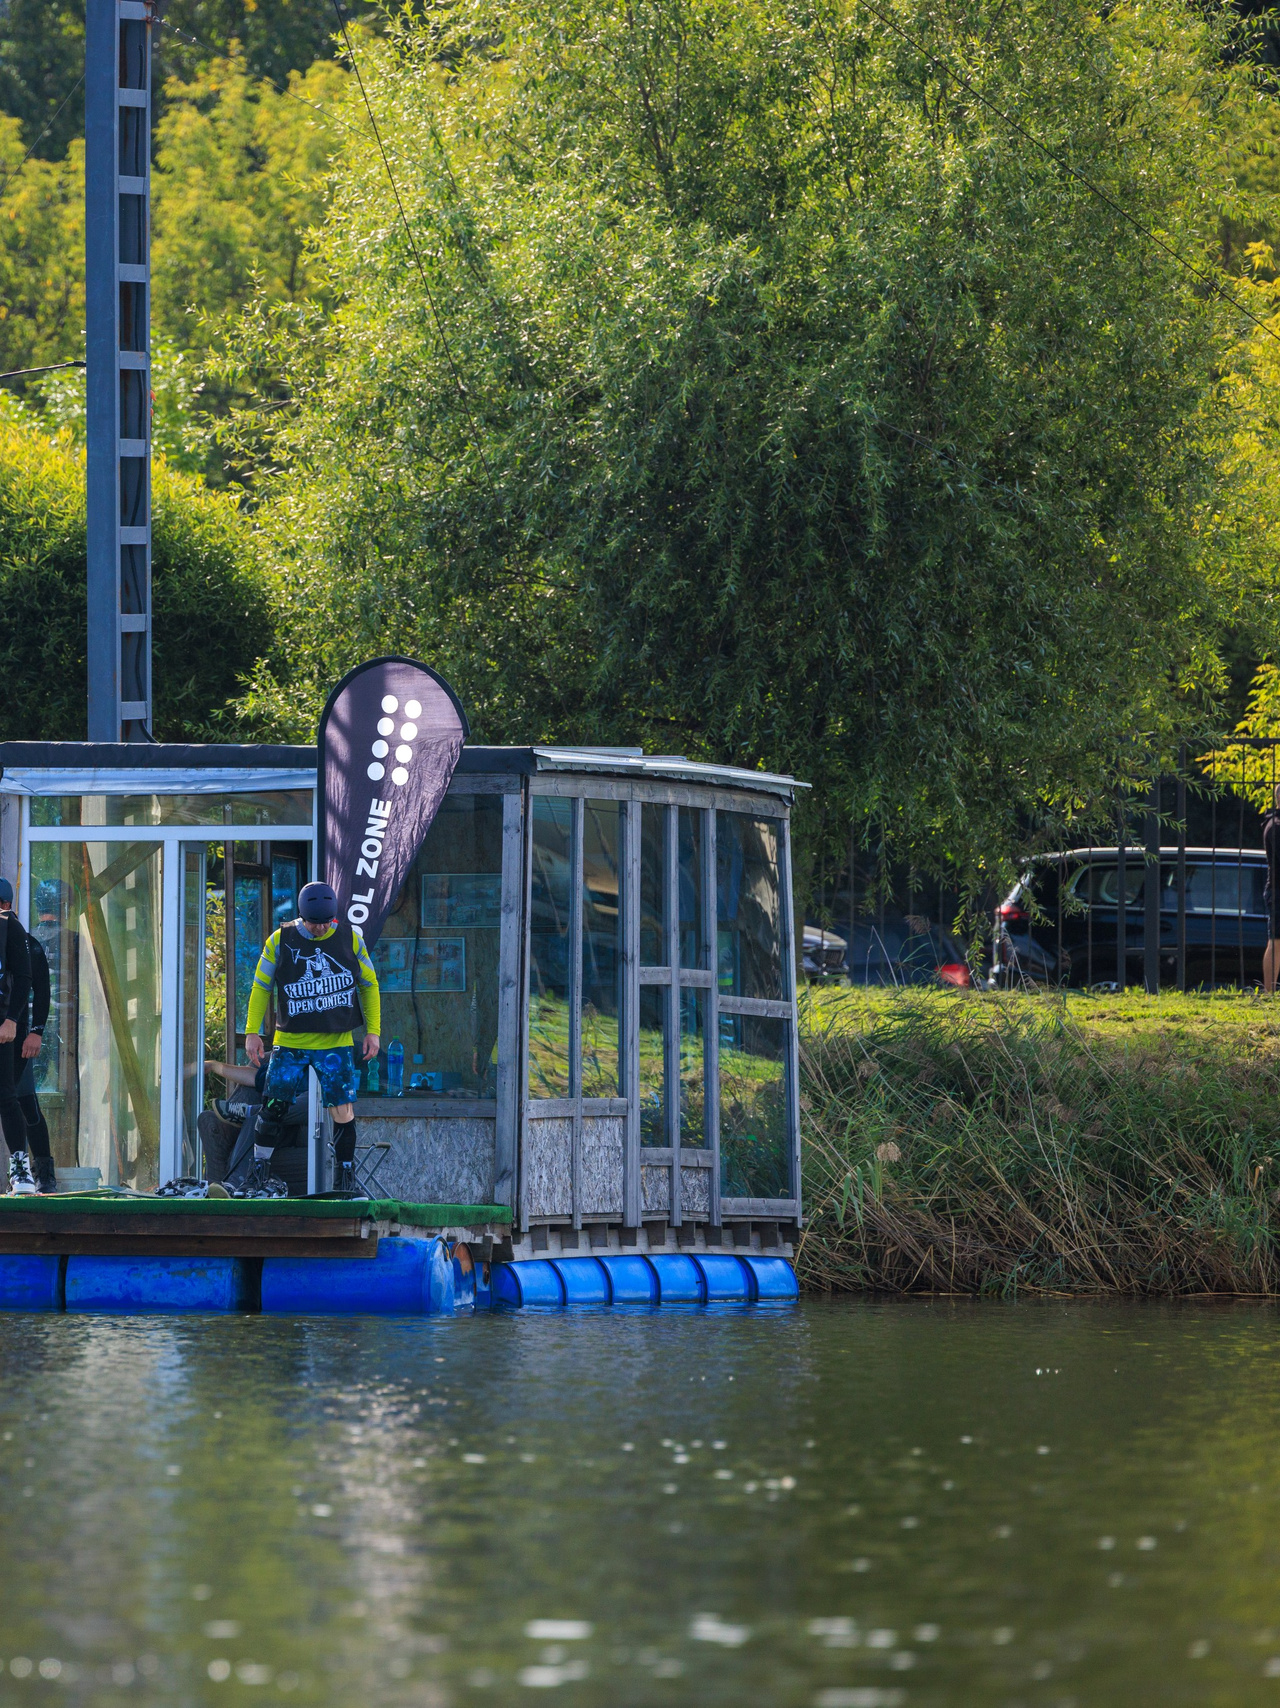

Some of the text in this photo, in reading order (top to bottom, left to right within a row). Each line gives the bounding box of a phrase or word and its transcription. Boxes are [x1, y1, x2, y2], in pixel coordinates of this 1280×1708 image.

[356, 797, 393, 879] ZONE
[284, 975, 354, 998] KUPCHINO
[287, 988, 354, 1016] OPEN CONTEST
